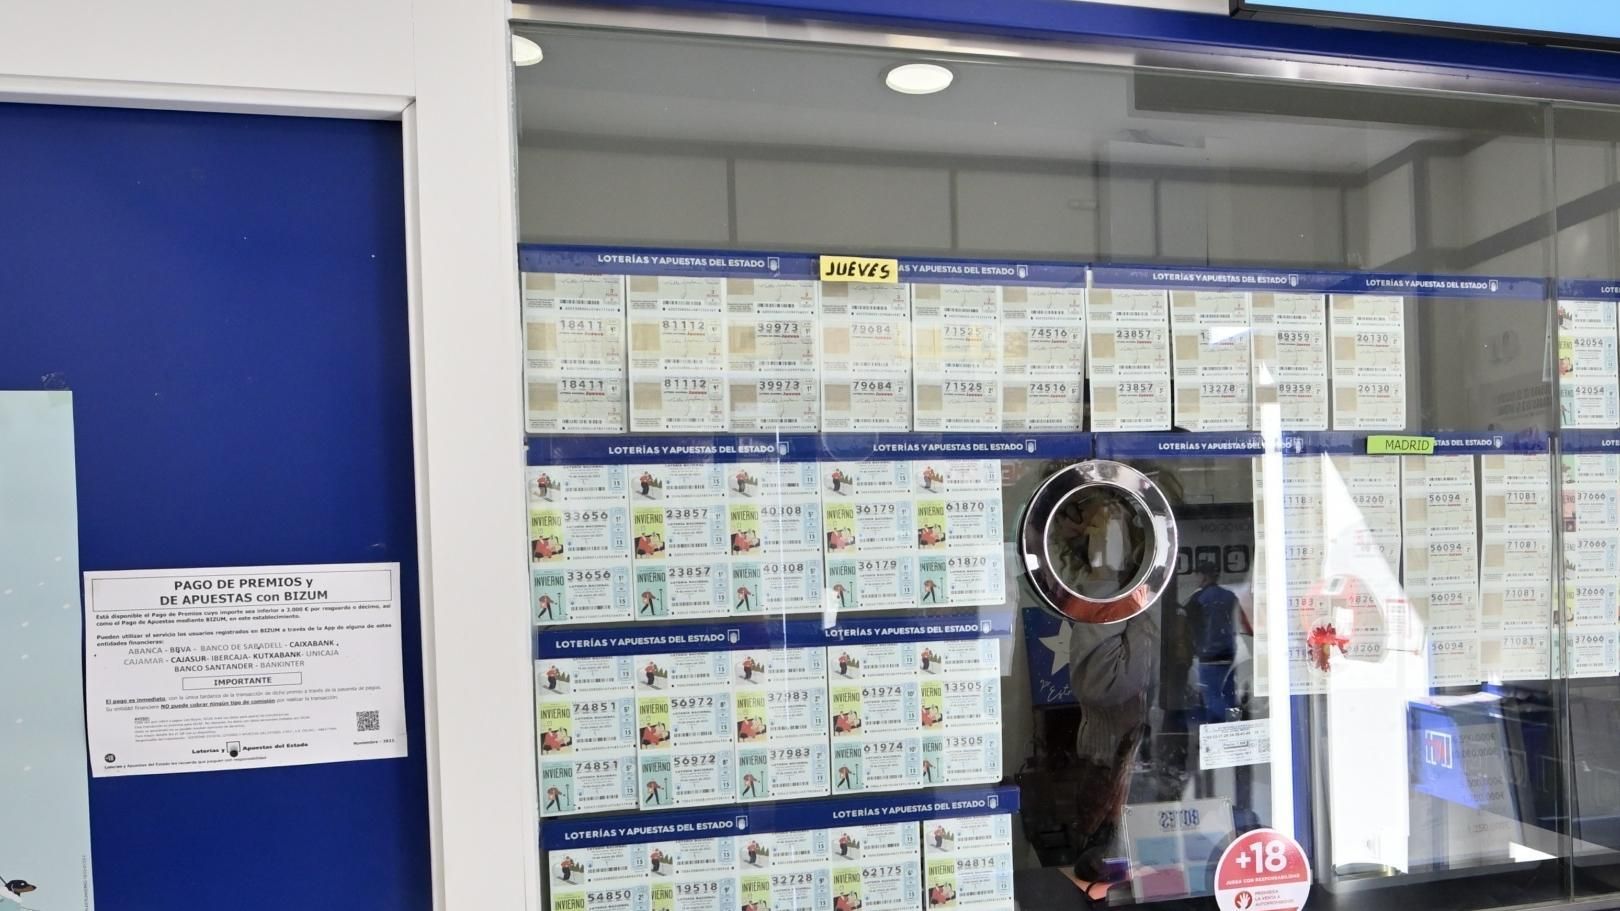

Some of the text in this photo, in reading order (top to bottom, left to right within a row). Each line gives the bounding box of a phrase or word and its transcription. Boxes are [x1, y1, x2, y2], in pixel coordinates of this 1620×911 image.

[598, 254, 650, 264] LOTERÍAS
[651, 256, 658, 264] Y
[659, 256, 708, 265] APUESTAS
[728, 259, 765, 267] ESTADO
[825, 261, 890, 279] JUEVES
[919, 265, 962, 274] APUESTAS
[981, 267, 1015, 275] ESTADO
[1153, 272, 1194, 281] LOTERÍAS
[1201, 274, 1240, 282] APUESTAS
[1257, 276, 1287, 284] ESTADO
[1366, 279, 1404, 287] LOTERÍAS
[1409, 280, 1445, 288] APUESTAS
[560, 319, 603, 330] 18411
[662, 320, 705, 329] 81112
[758, 322, 798, 333] 39973
[852, 325, 890, 335] 79684
[1030, 328, 1067, 338] 74516
[1116, 330, 1151, 339] 23857
[1277, 332, 1310, 342] 89359
[1356, 334, 1389, 342] 26130
[1574, 338, 1603, 347] 42054
[561, 379, 604, 389] 18411
[664, 378, 706, 388] 81112
[759, 380, 800, 390] 39973
[853, 381, 892, 390] 79684
[944, 382, 983, 391] 71525
[1029, 383, 1066, 393] 74516
[1119, 383, 1153, 392] 23857
[1202, 384, 1235, 393] 13278
[1279, 384, 1312, 393] 89359
[1357, 384, 1390, 393] 26130
[1575, 386, 1604, 394] 42054
[609, 445, 660, 455] LOTERÍAS
[669, 446, 717, 454] APUESTAS
[873, 443, 919, 451] LOTERÍAS
[972, 443, 988, 451] DEL
[990, 443, 1023, 451] ESTADO
[1158, 440, 1199, 451] LOTERÍAS
[1208, 442, 1246, 450] APUESTAS
[1385, 439, 1430, 451] MADRID
[1429, 494, 1460, 502] 56094
[761, 506, 801, 516] 40308
[856, 504, 895, 514] 36179
[946, 502, 985, 511] 61870
[564, 511, 608, 521] 33656
[634, 512, 663, 524] INVIERNO
[666, 509, 708, 519] 23857
[858, 560, 897, 570] 36179
[948, 557, 986, 566] 61870
[669, 567, 711, 577] 23857
[763, 564, 804, 573] 40308
[567, 570, 611, 581] 33656
[174, 577, 313, 590] PAGO DE PREMIOS y
[160, 591, 328, 605] DE APUESTAS con BIZUM
[825, 624, 978, 638] LOTERÍAS Y APUESTAS DEL ESTADO
[556, 637, 607, 649] LOTERÍAS
[610, 638, 616, 646] Y
[618, 636, 666, 646] APUESTAS
[688, 634, 725, 642] ESTADO
[128, 647, 162, 655] ABANCA
[200, 644, 228, 652] BANCO
[244, 642, 282, 650] SABADELL
[205, 663, 253, 671] SANTANDER
[214, 677, 272, 686] IMPORTANTE
[862, 686, 901, 697] 61974
[945, 682, 982, 692] 13505
[768, 691, 808, 701] 37983
[574, 702, 616, 712] 74851
[672, 697, 713, 708] 56972
[946, 737, 983, 746] 13505
[864, 742, 903, 752] 61974
[769, 749, 810, 758] 37983
[835, 748, 862, 758] INVIERNO
[674, 755, 716, 765] 56972
[575, 760, 618, 771] 74851
[543, 768, 573, 779] INVIERNO
[833, 808, 880, 819] LOTERÍAS
[889, 805, 933, 815] APUESTAS
[952, 800, 985, 809] ESTADO
[565, 829, 617, 840] LOTERÍAS
[627, 825, 675, 836] APUESTAS
[677, 824, 694, 832] DEL
[697, 821, 733, 831] ESTADO
[1235, 840, 1287, 873] +18
[957, 858, 995, 869] 94814
[862, 866, 902, 877] 62175
[772, 874, 812, 886] 32728
[676, 883, 718, 894] 19518
[587, 890, 631, 902] 54850
